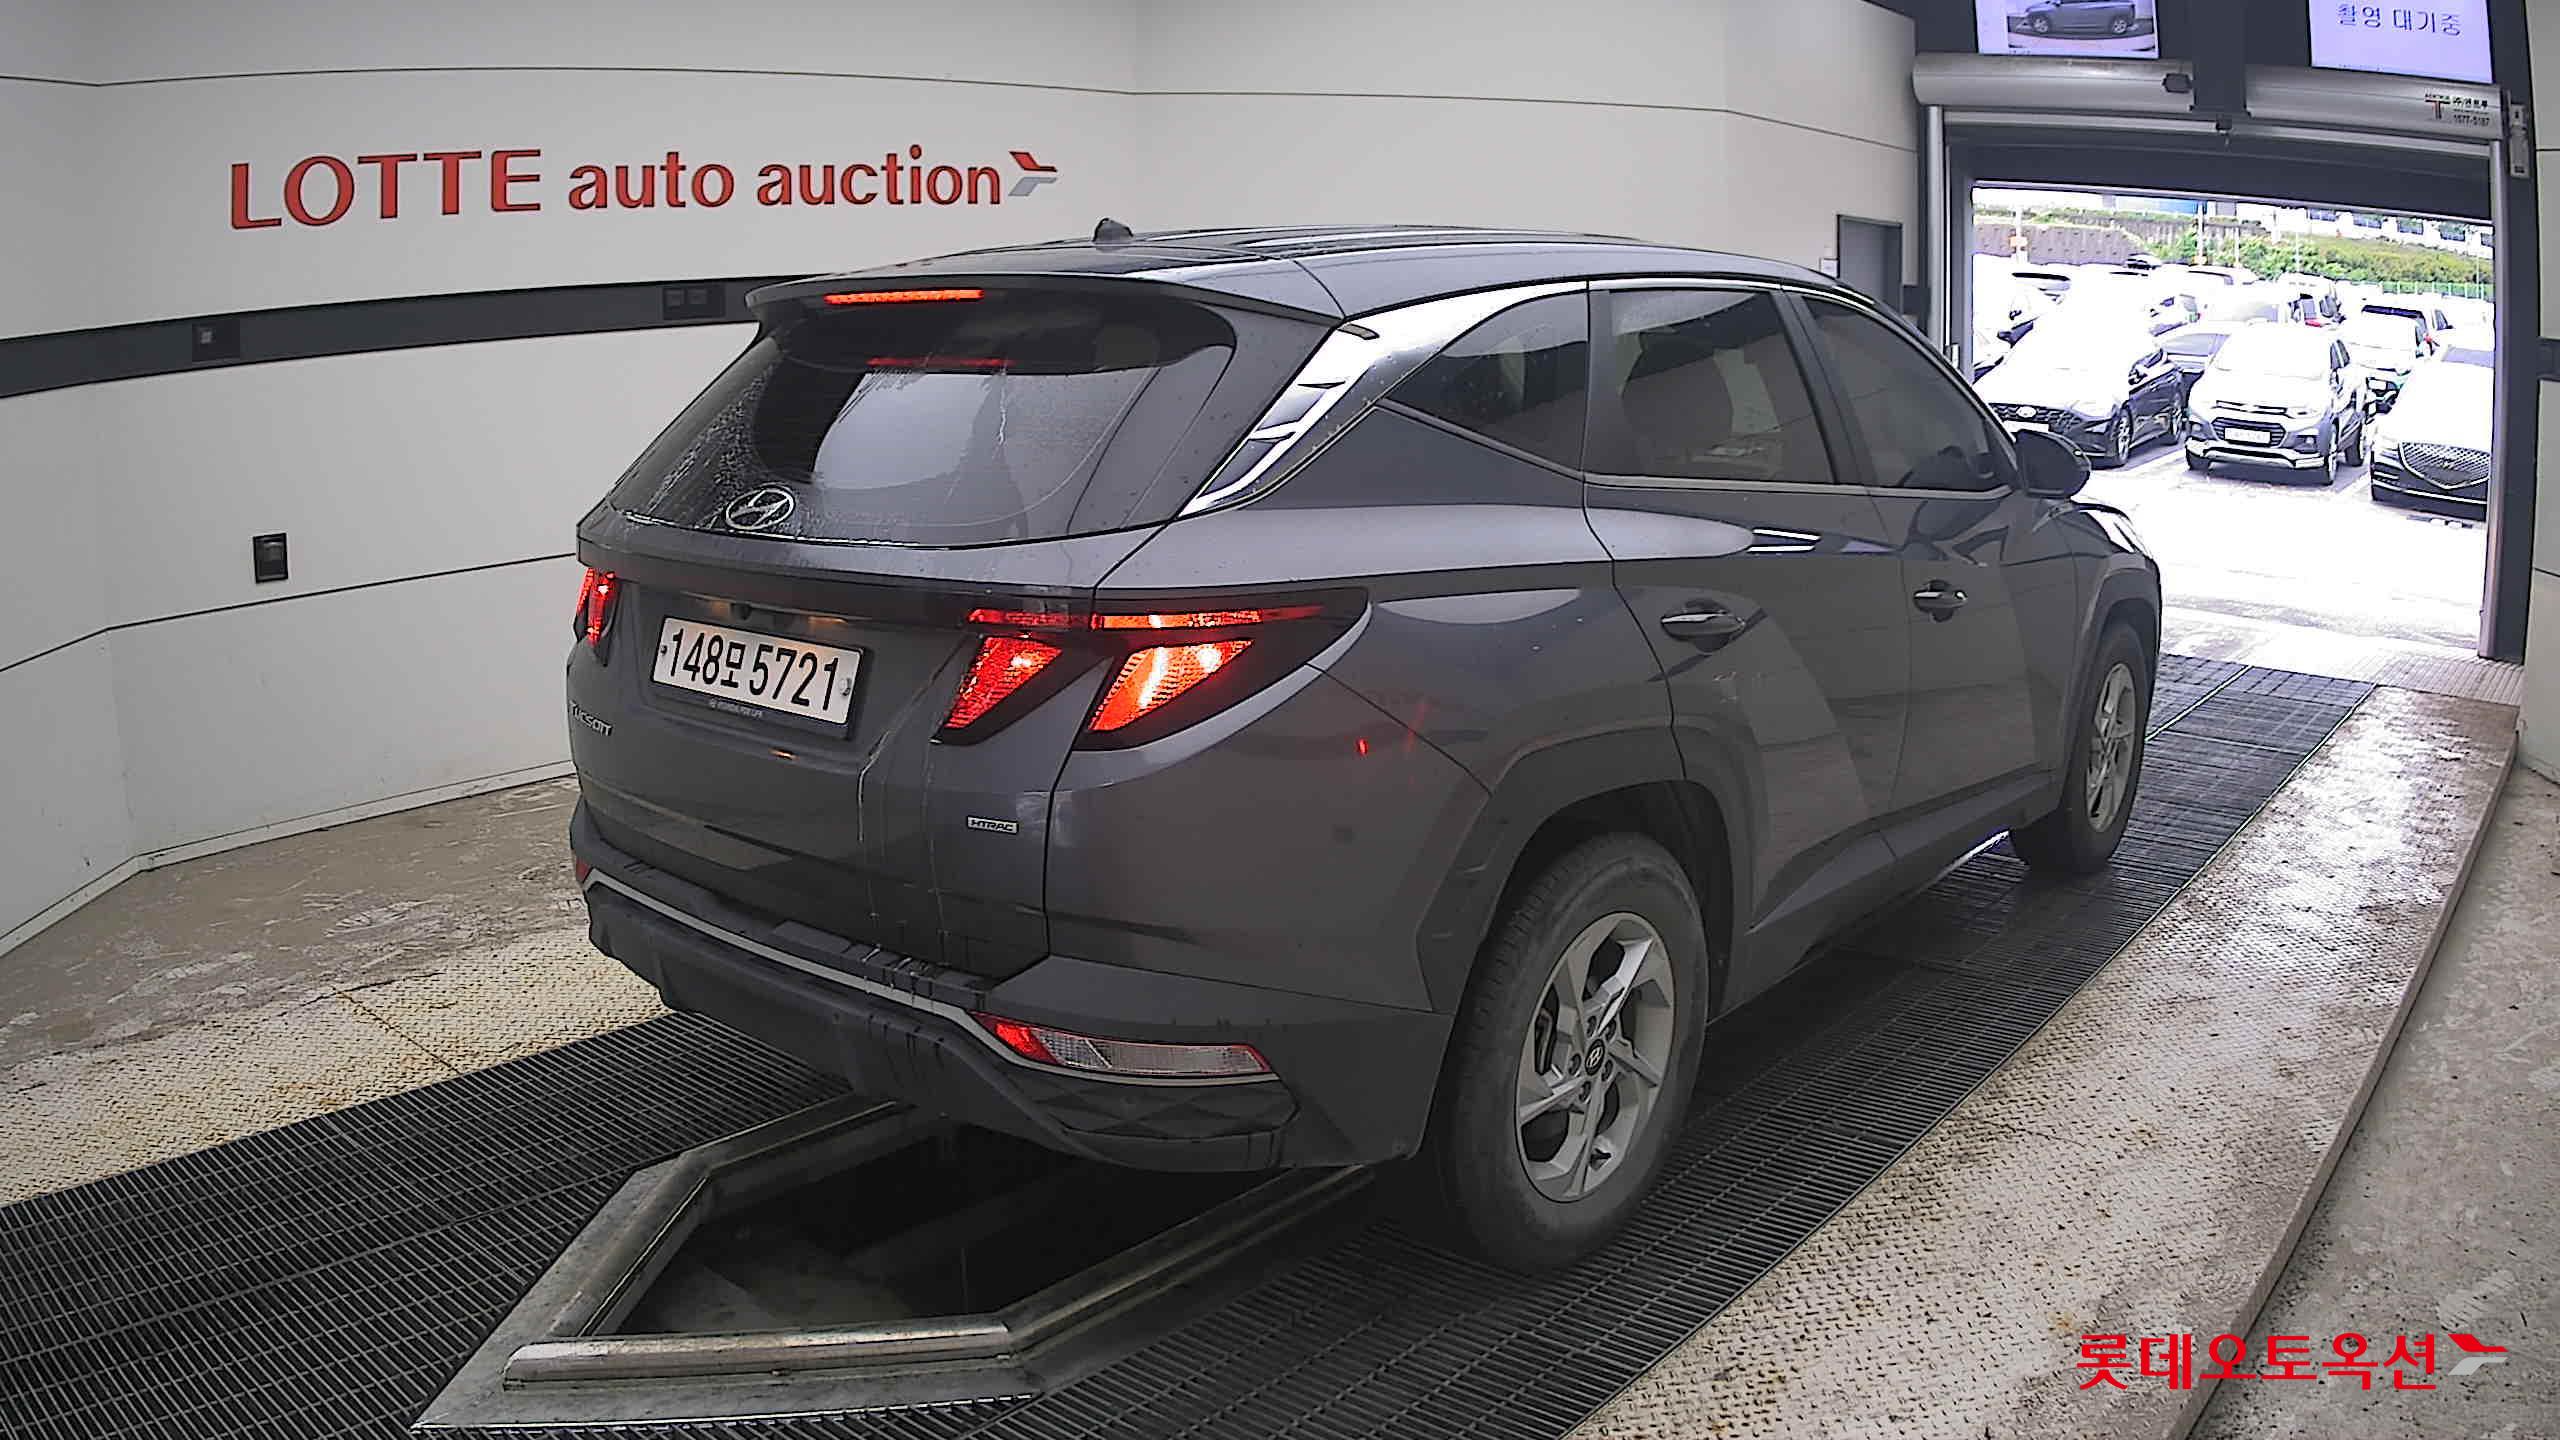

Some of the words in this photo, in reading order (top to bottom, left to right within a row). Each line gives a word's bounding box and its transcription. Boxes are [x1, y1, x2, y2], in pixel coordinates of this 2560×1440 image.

[2393, 8, 2461, 36] 대기중
[231, 149, 541, 230] LOTTE
[568, 151, 735, 209] auto
[756, 146, 1001, 206] auction
[749, 643, 838, 710] 5721
